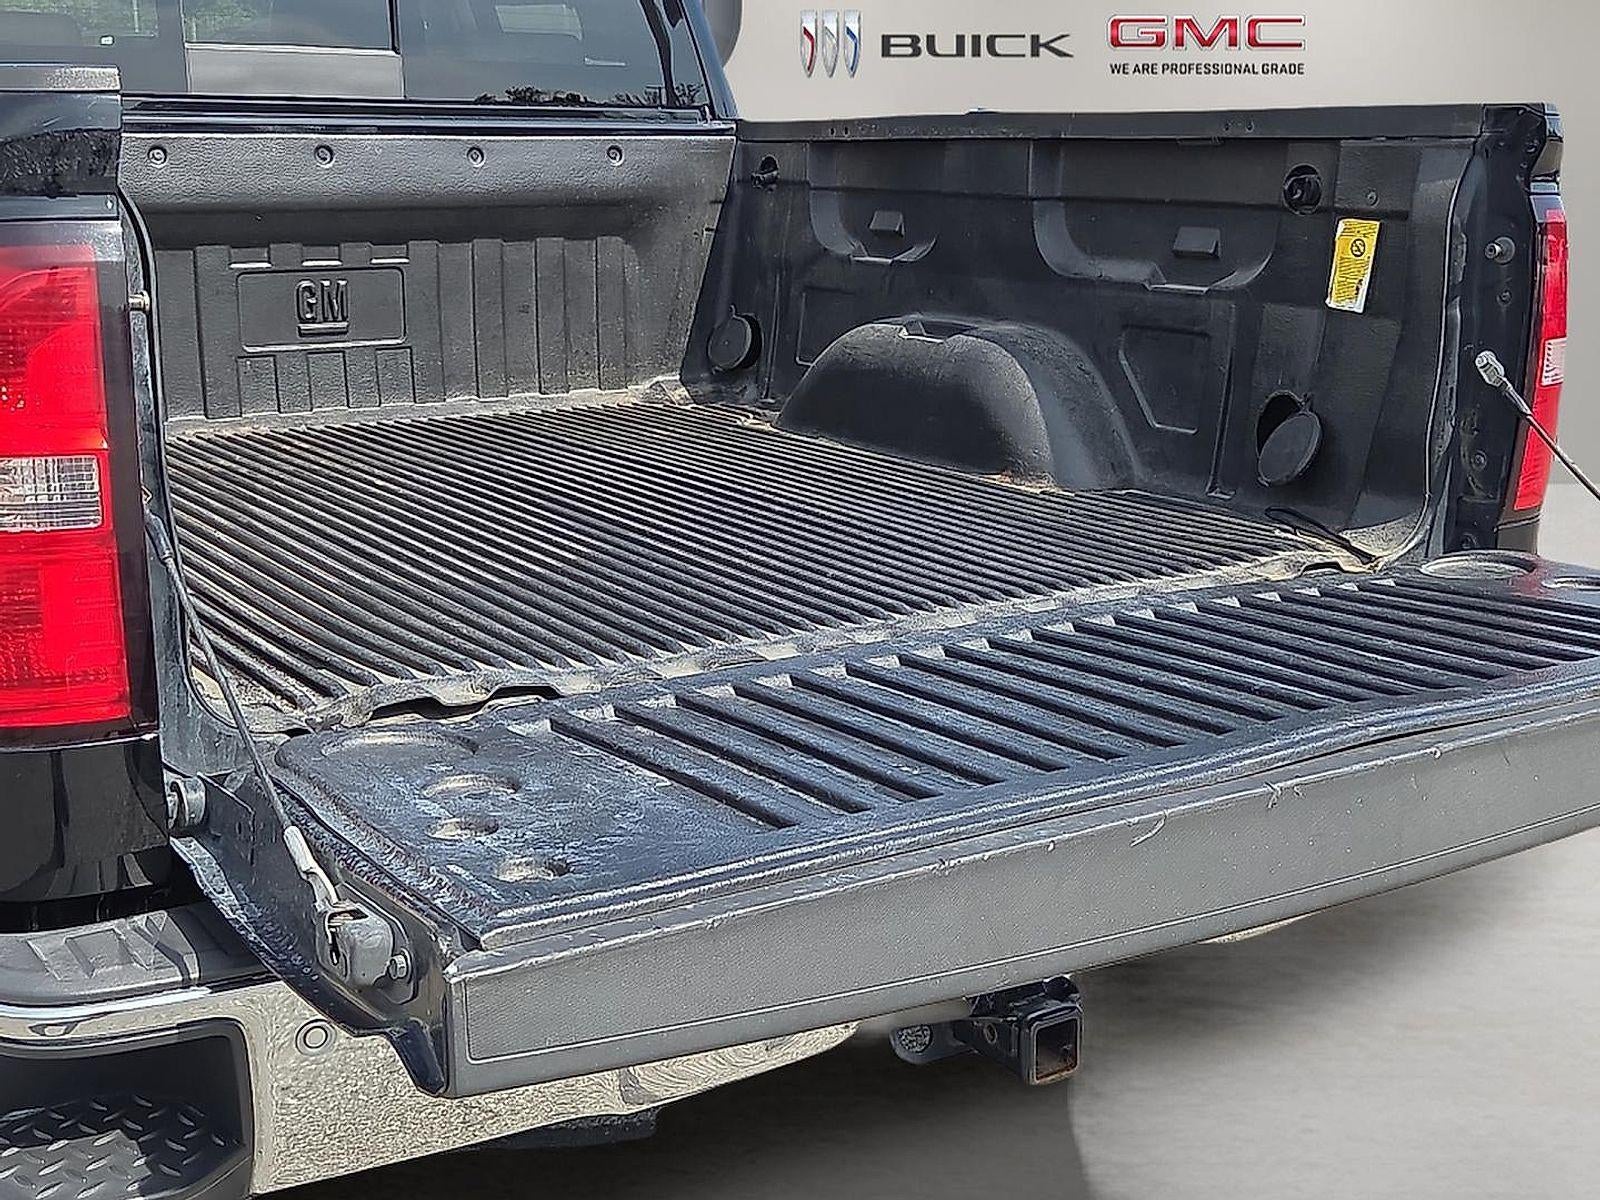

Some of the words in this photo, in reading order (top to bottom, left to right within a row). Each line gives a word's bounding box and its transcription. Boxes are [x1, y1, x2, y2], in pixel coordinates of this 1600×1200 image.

[881, 34, 1074, 58] BUICK
[1108, 15, 1306, 50] GMC
[1110, 62, 1129, 75] WE
[1132, 62, 1158, 75] ARE
[1161, 62, 1259, 75] PROFESSIONAL
[1261, 62, 1305, 75] GRADE
[296, 279, 349, 323] GM
